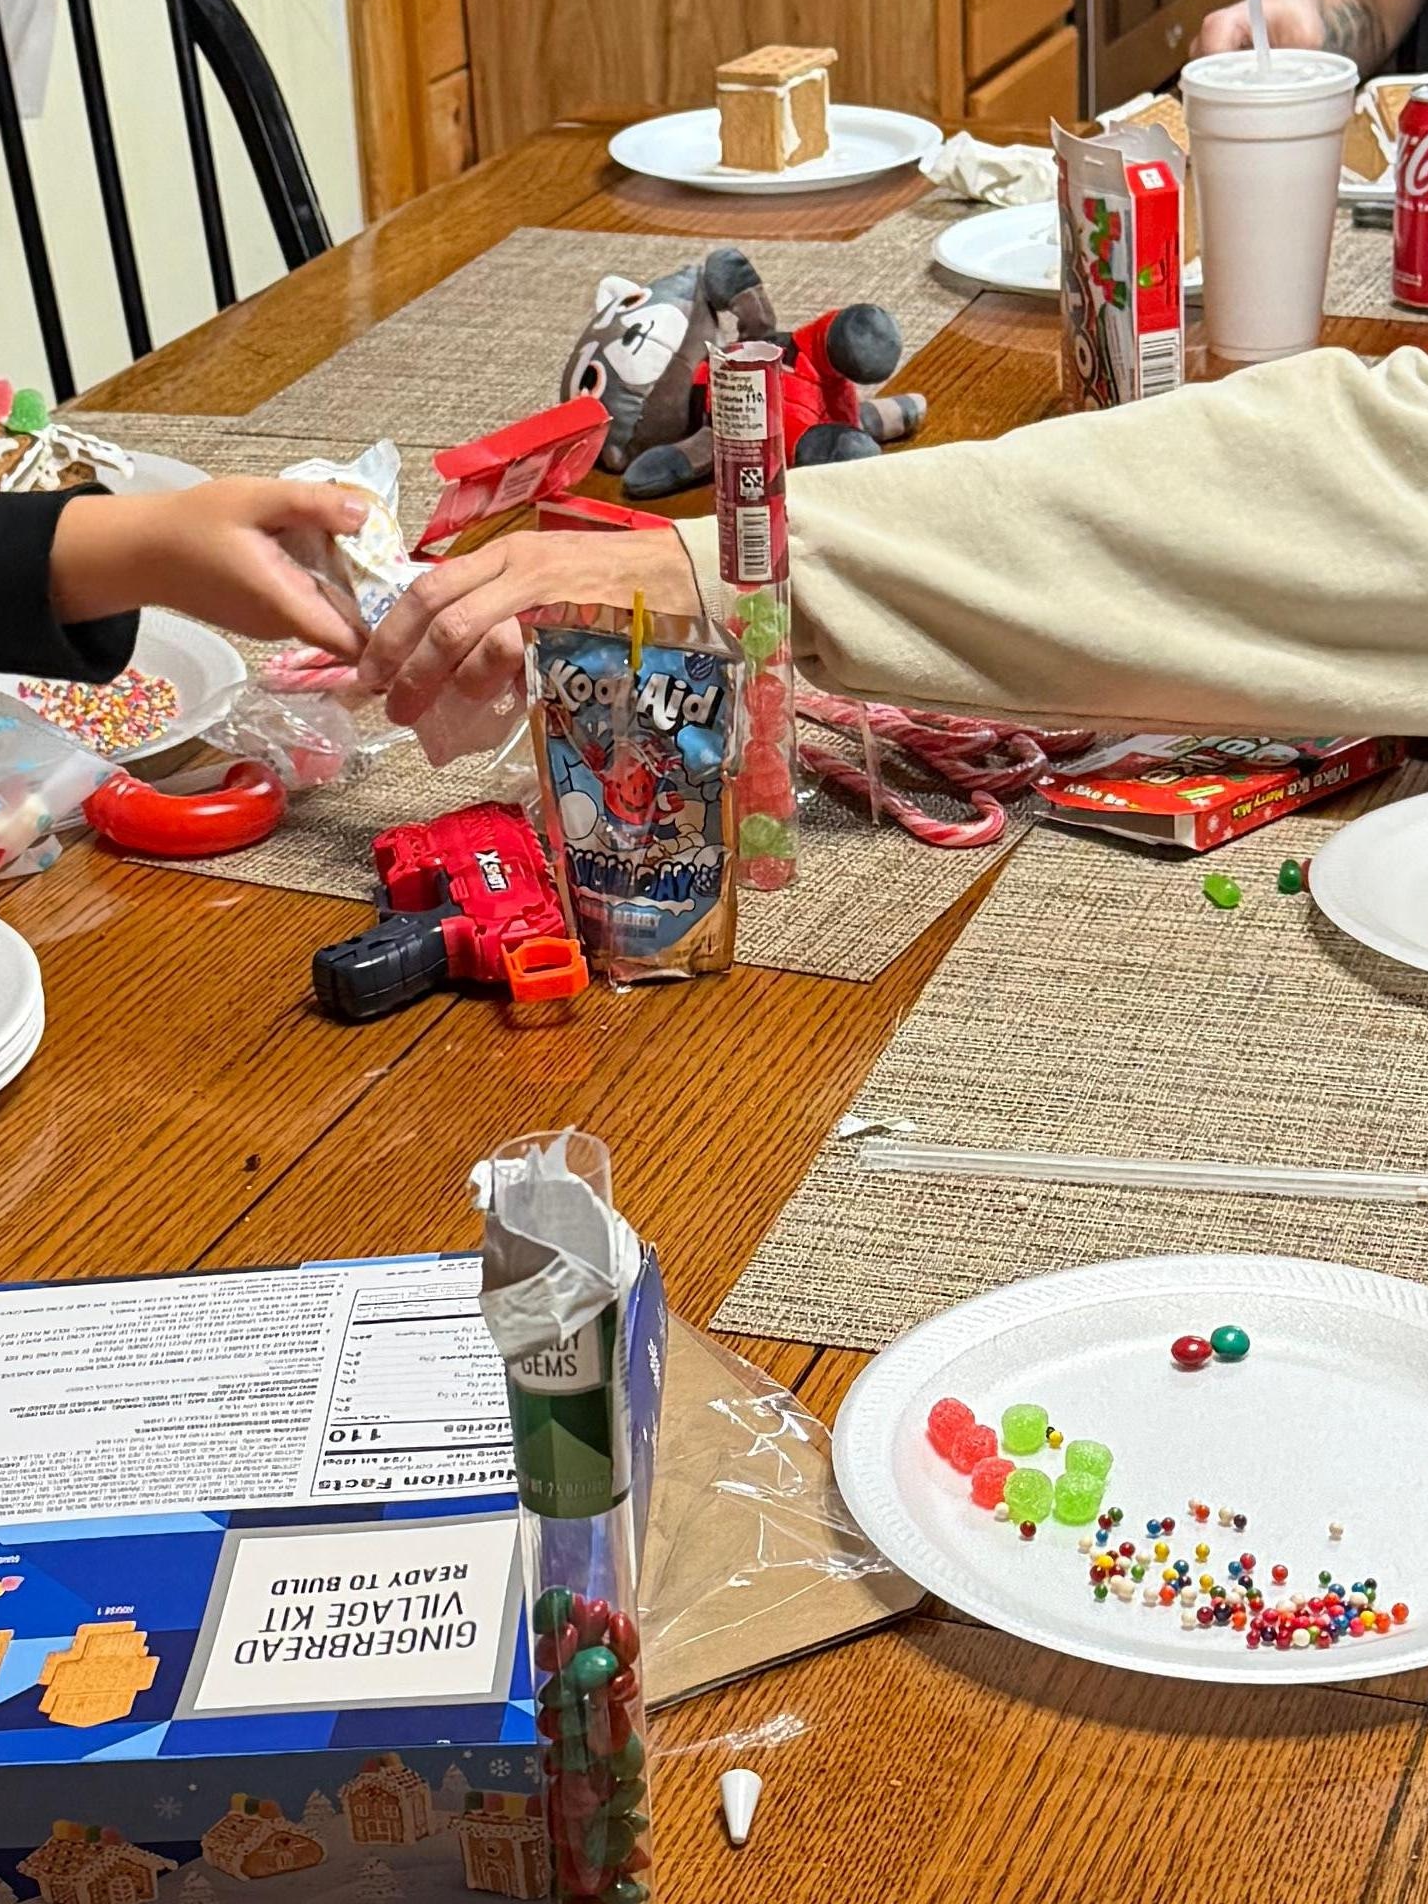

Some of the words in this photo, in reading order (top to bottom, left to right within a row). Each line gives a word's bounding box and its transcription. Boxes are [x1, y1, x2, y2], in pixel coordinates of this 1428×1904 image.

[521, 1353, 578, 1377] GEMS
[328, 1428, 382, 1444] 110
[318, 1478, 393, 1493] Facts
[403, 1469, 516, 1488] Nutrition
[270, 1574, 342, 1597] BUILD
[348, 1573, 380, 1592] TO
[387, 1564, 469, 1589] READY
[258, 1604, 315, 1634] KIT
[326, 1590, 465, 1629] VILLAGE
[234, 1620, 478, 1665] GINGERBREAD
